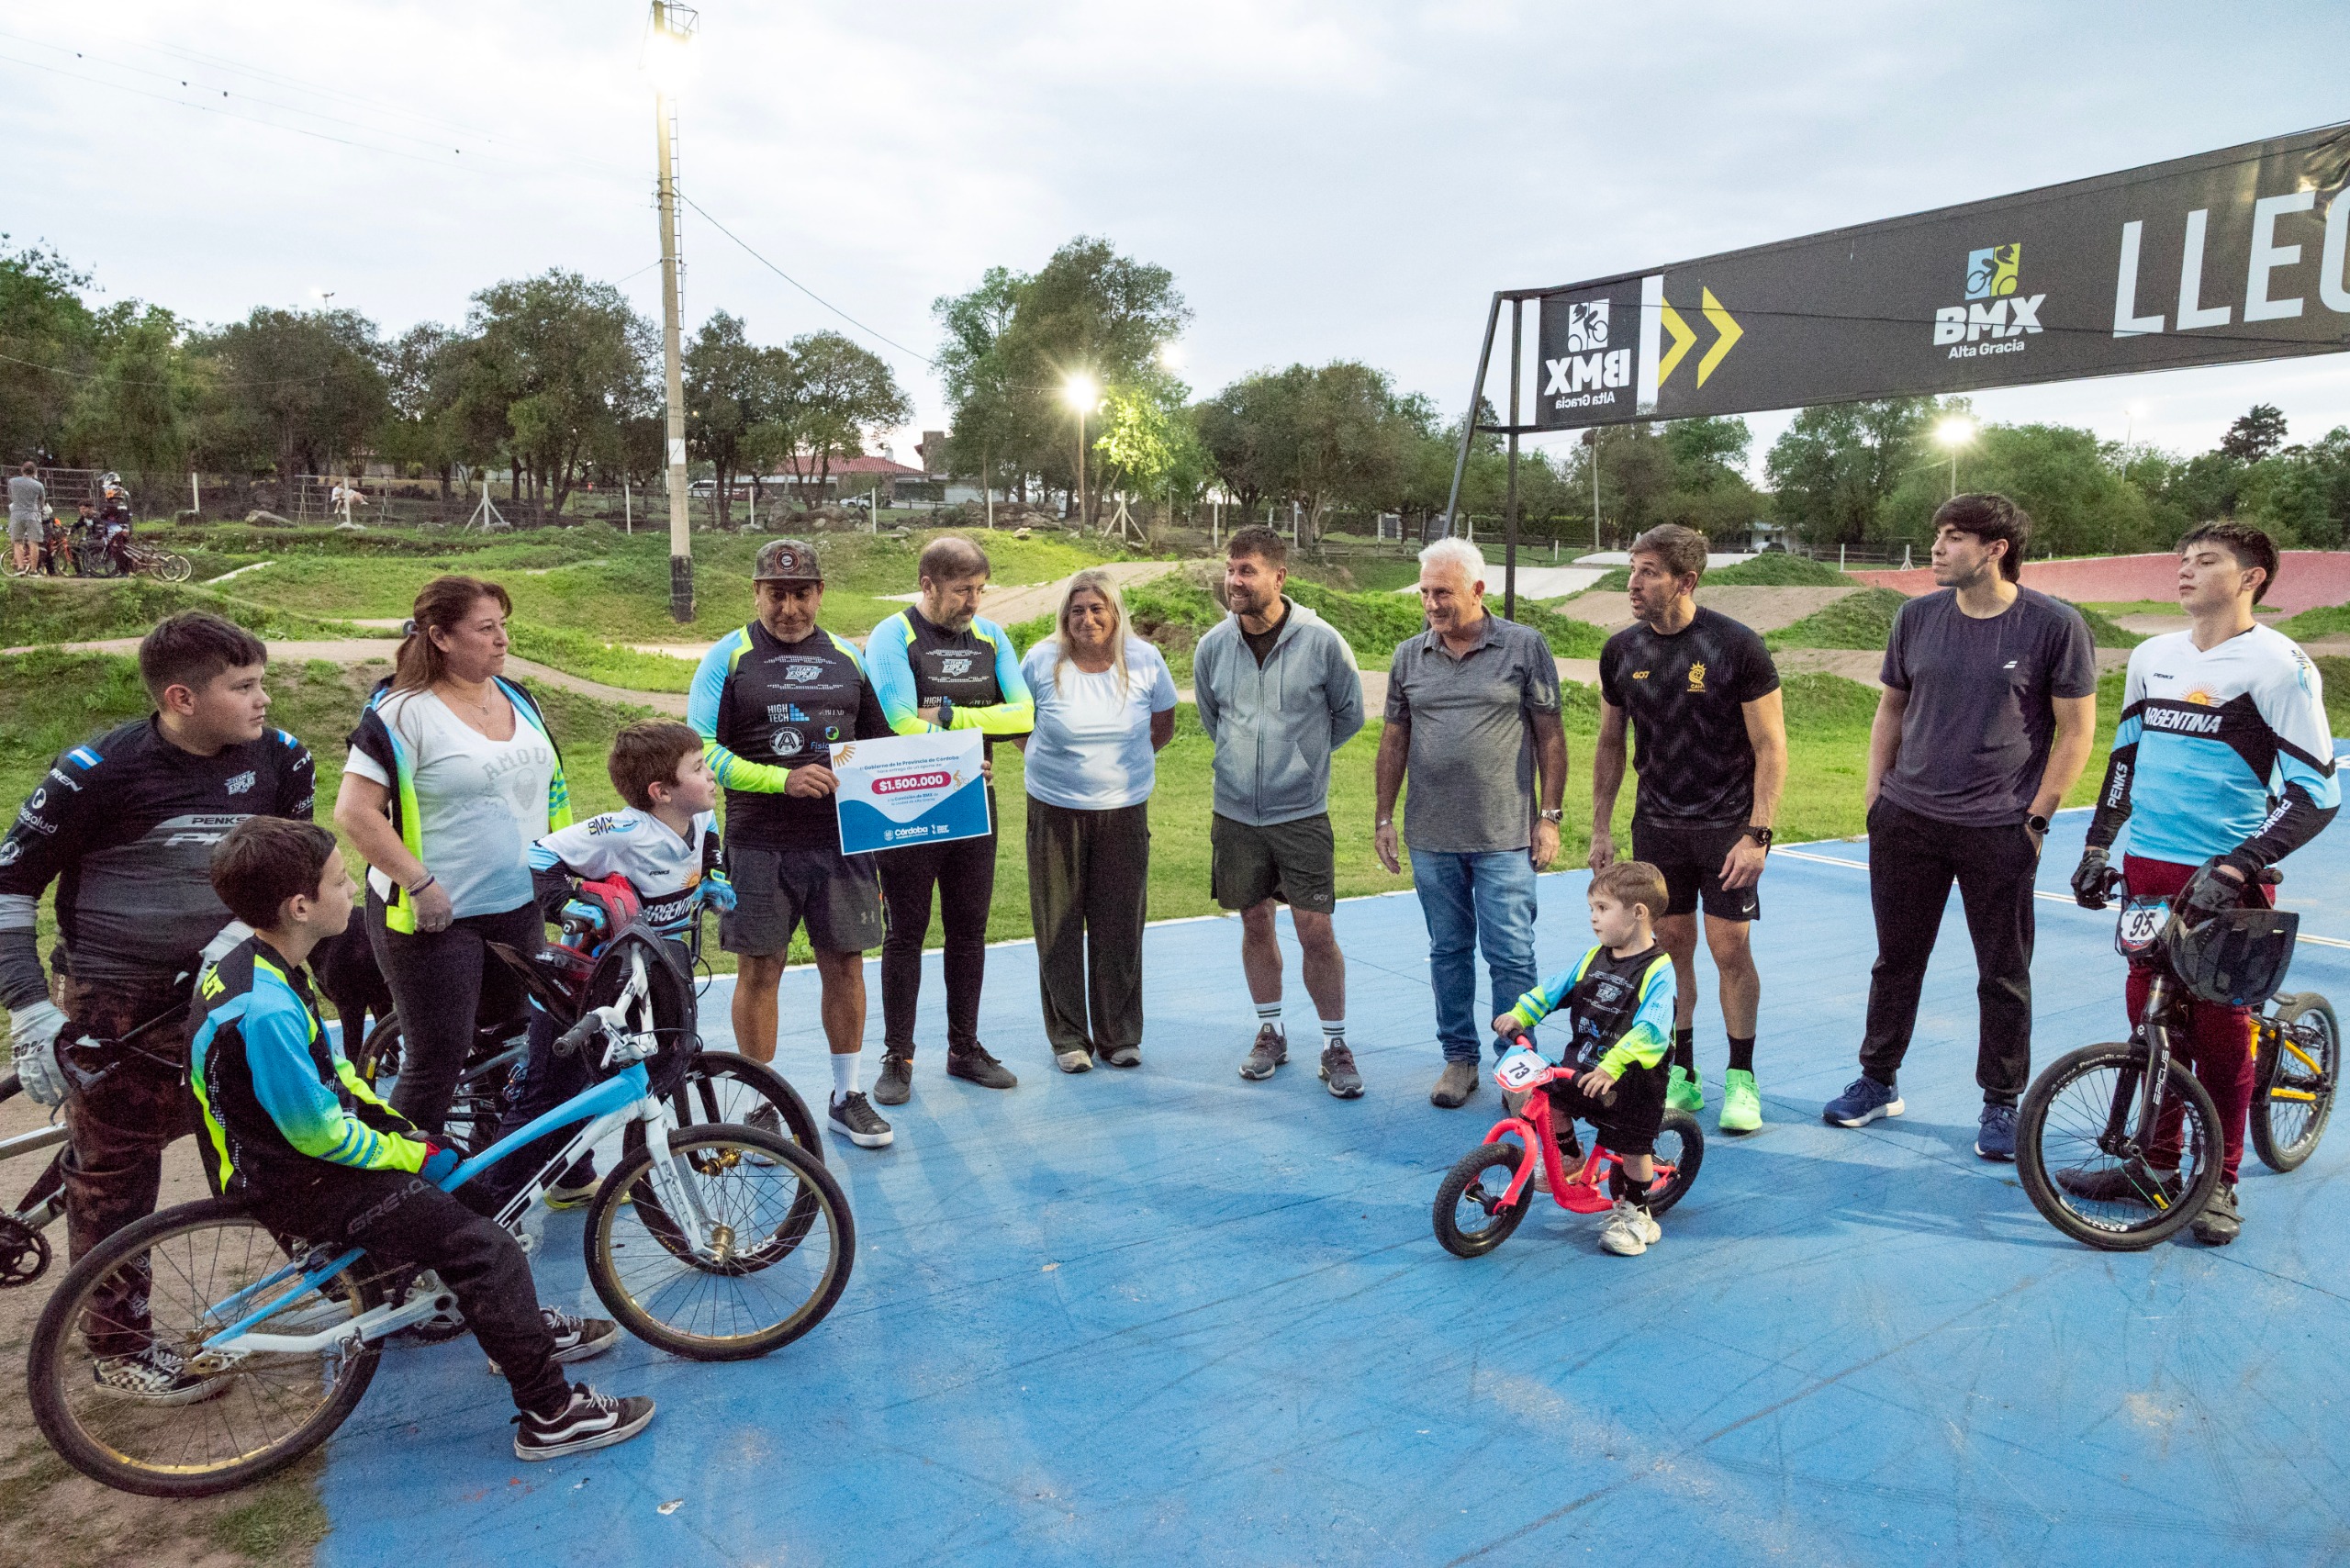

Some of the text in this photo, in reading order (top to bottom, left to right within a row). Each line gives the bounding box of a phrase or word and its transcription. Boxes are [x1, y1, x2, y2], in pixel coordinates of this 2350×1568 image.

[1933, 294, 2046, 346] BMX
[1948, 339, 2025, 359] Alta Gracia
[767, 703, 788, 713] HIGH
[923, 696, 943, 705] HIGH
[767, 713, 789, 722] TECH
[2143, 706, 2223, 734] ARGENTINA
[482, 746, 553, 781] AMOU
[229, 776, 255, 793] ESPEJO
[231, 774, 247, 782] TEAM
[878, 774, 944, 791] $1.500.000
[2107, 761, 2129, 809] PENKS
[191, 816, 247, 824] PENKS
[2251, 797, 2292, 839] PENKS
[894, 825, 928, 836] Córdoba
[2129, 912, 2156, 938] 95
[14, 1038, 45, 1058] 00%
[1508, 1061, 1530, 1080] 73
[2153, 1049, 2170, 1105] EPICUS
